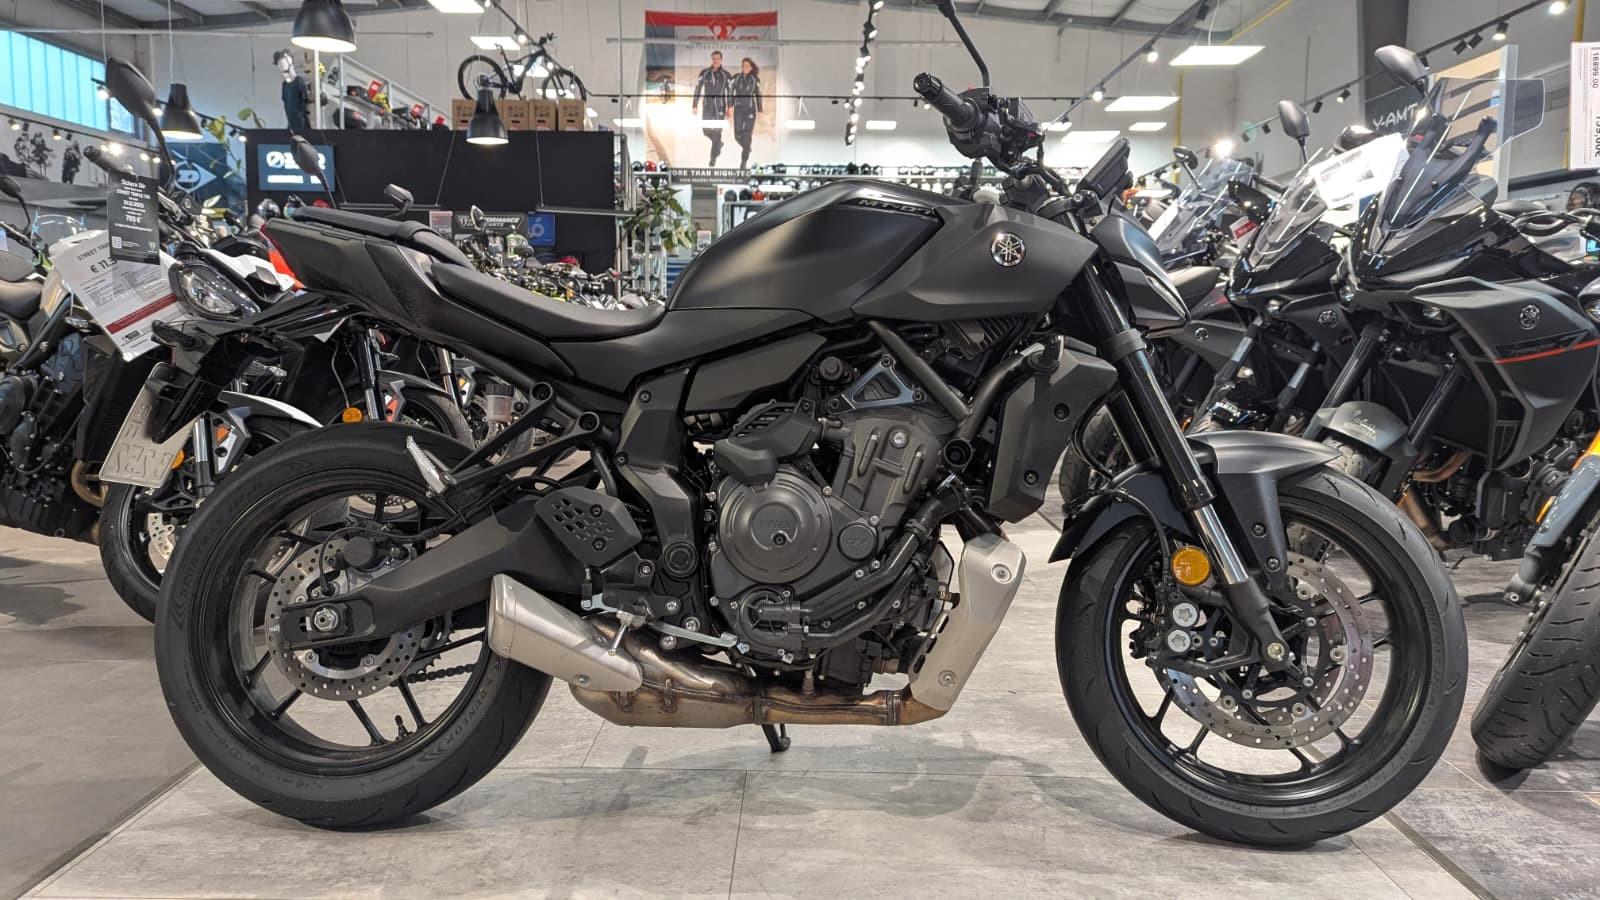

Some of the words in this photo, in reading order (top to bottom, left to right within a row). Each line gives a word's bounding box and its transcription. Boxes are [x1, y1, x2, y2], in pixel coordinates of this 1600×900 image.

[1372, 102, 1419, 130] Y-AMT
[691, 169, 711, 177] THAN
[858, 199, 935, 215] MT-07
